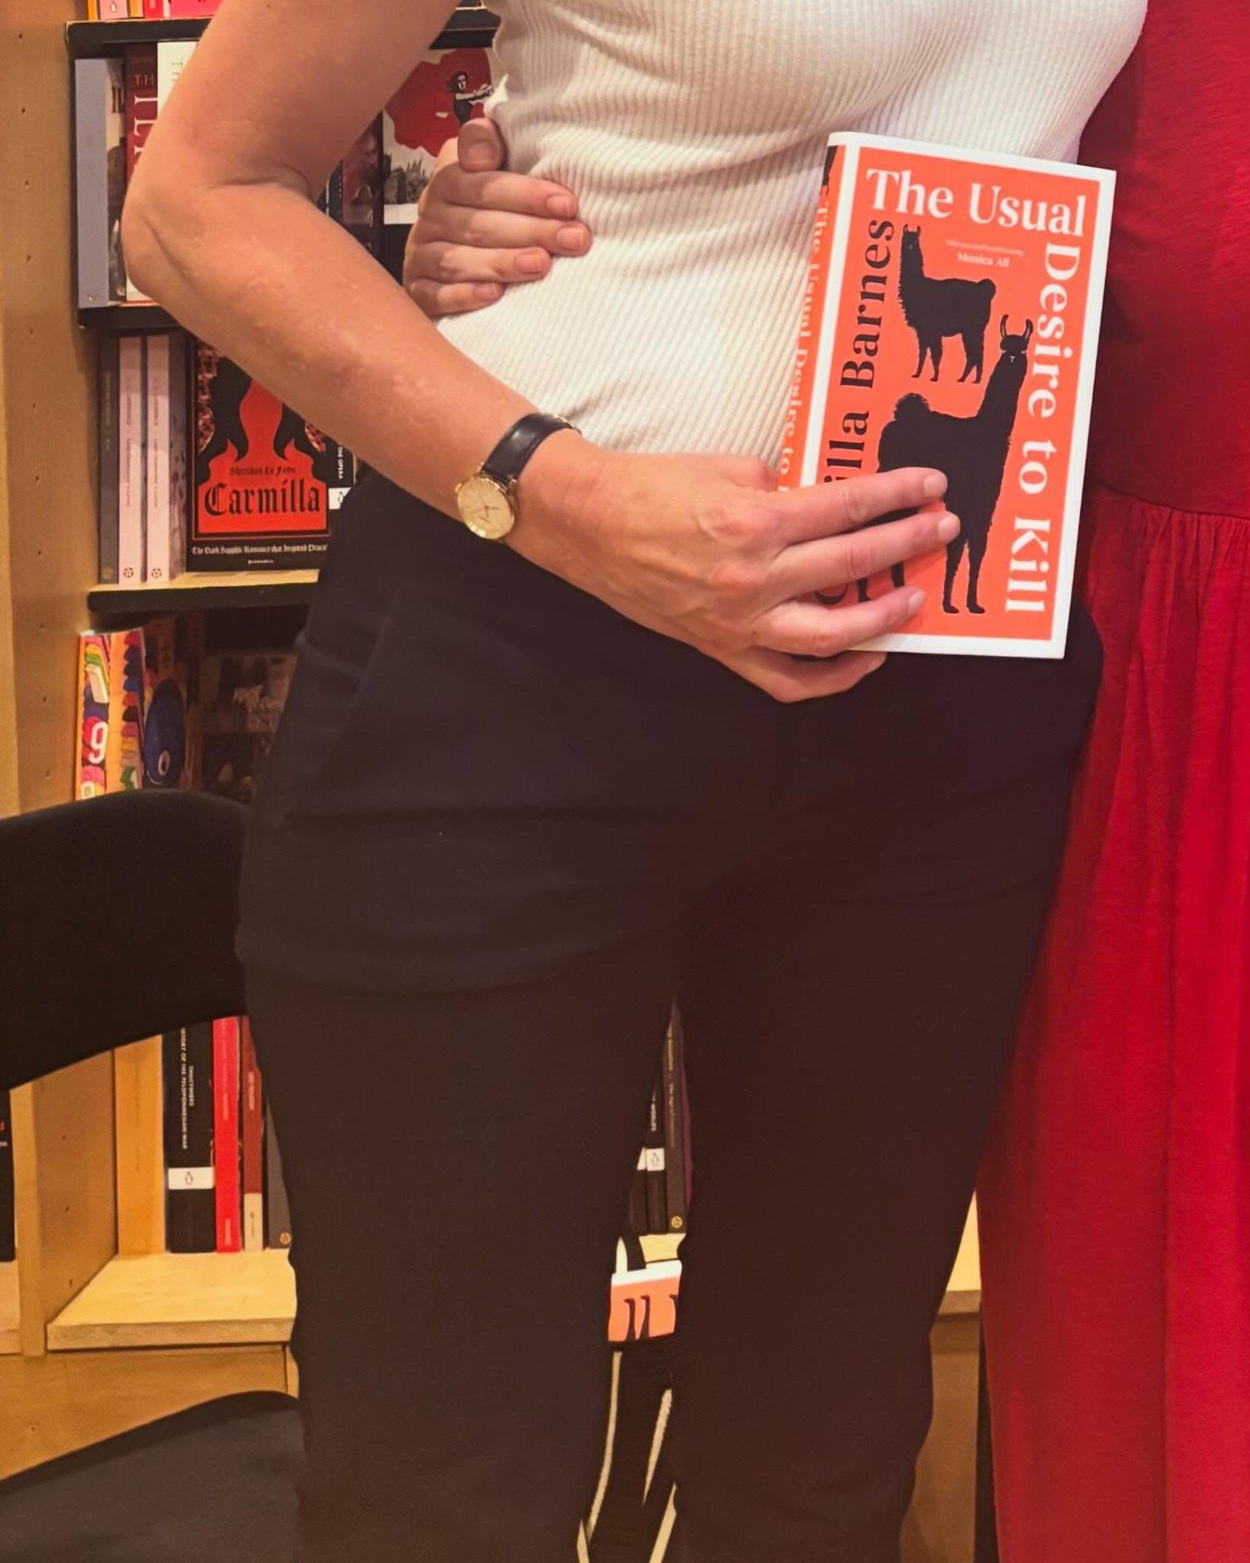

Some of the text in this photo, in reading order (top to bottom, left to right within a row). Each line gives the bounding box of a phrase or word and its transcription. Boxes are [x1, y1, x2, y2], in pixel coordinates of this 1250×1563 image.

[866, 168, 1087, 238] The Usual
[958, 252, 1010, 267] Monica Ali
[841, 219, 894, 390] Barnes
[1005, 242, 1080, 614] Desire to Kill
[204, 479, 320, 517] Carmilla
